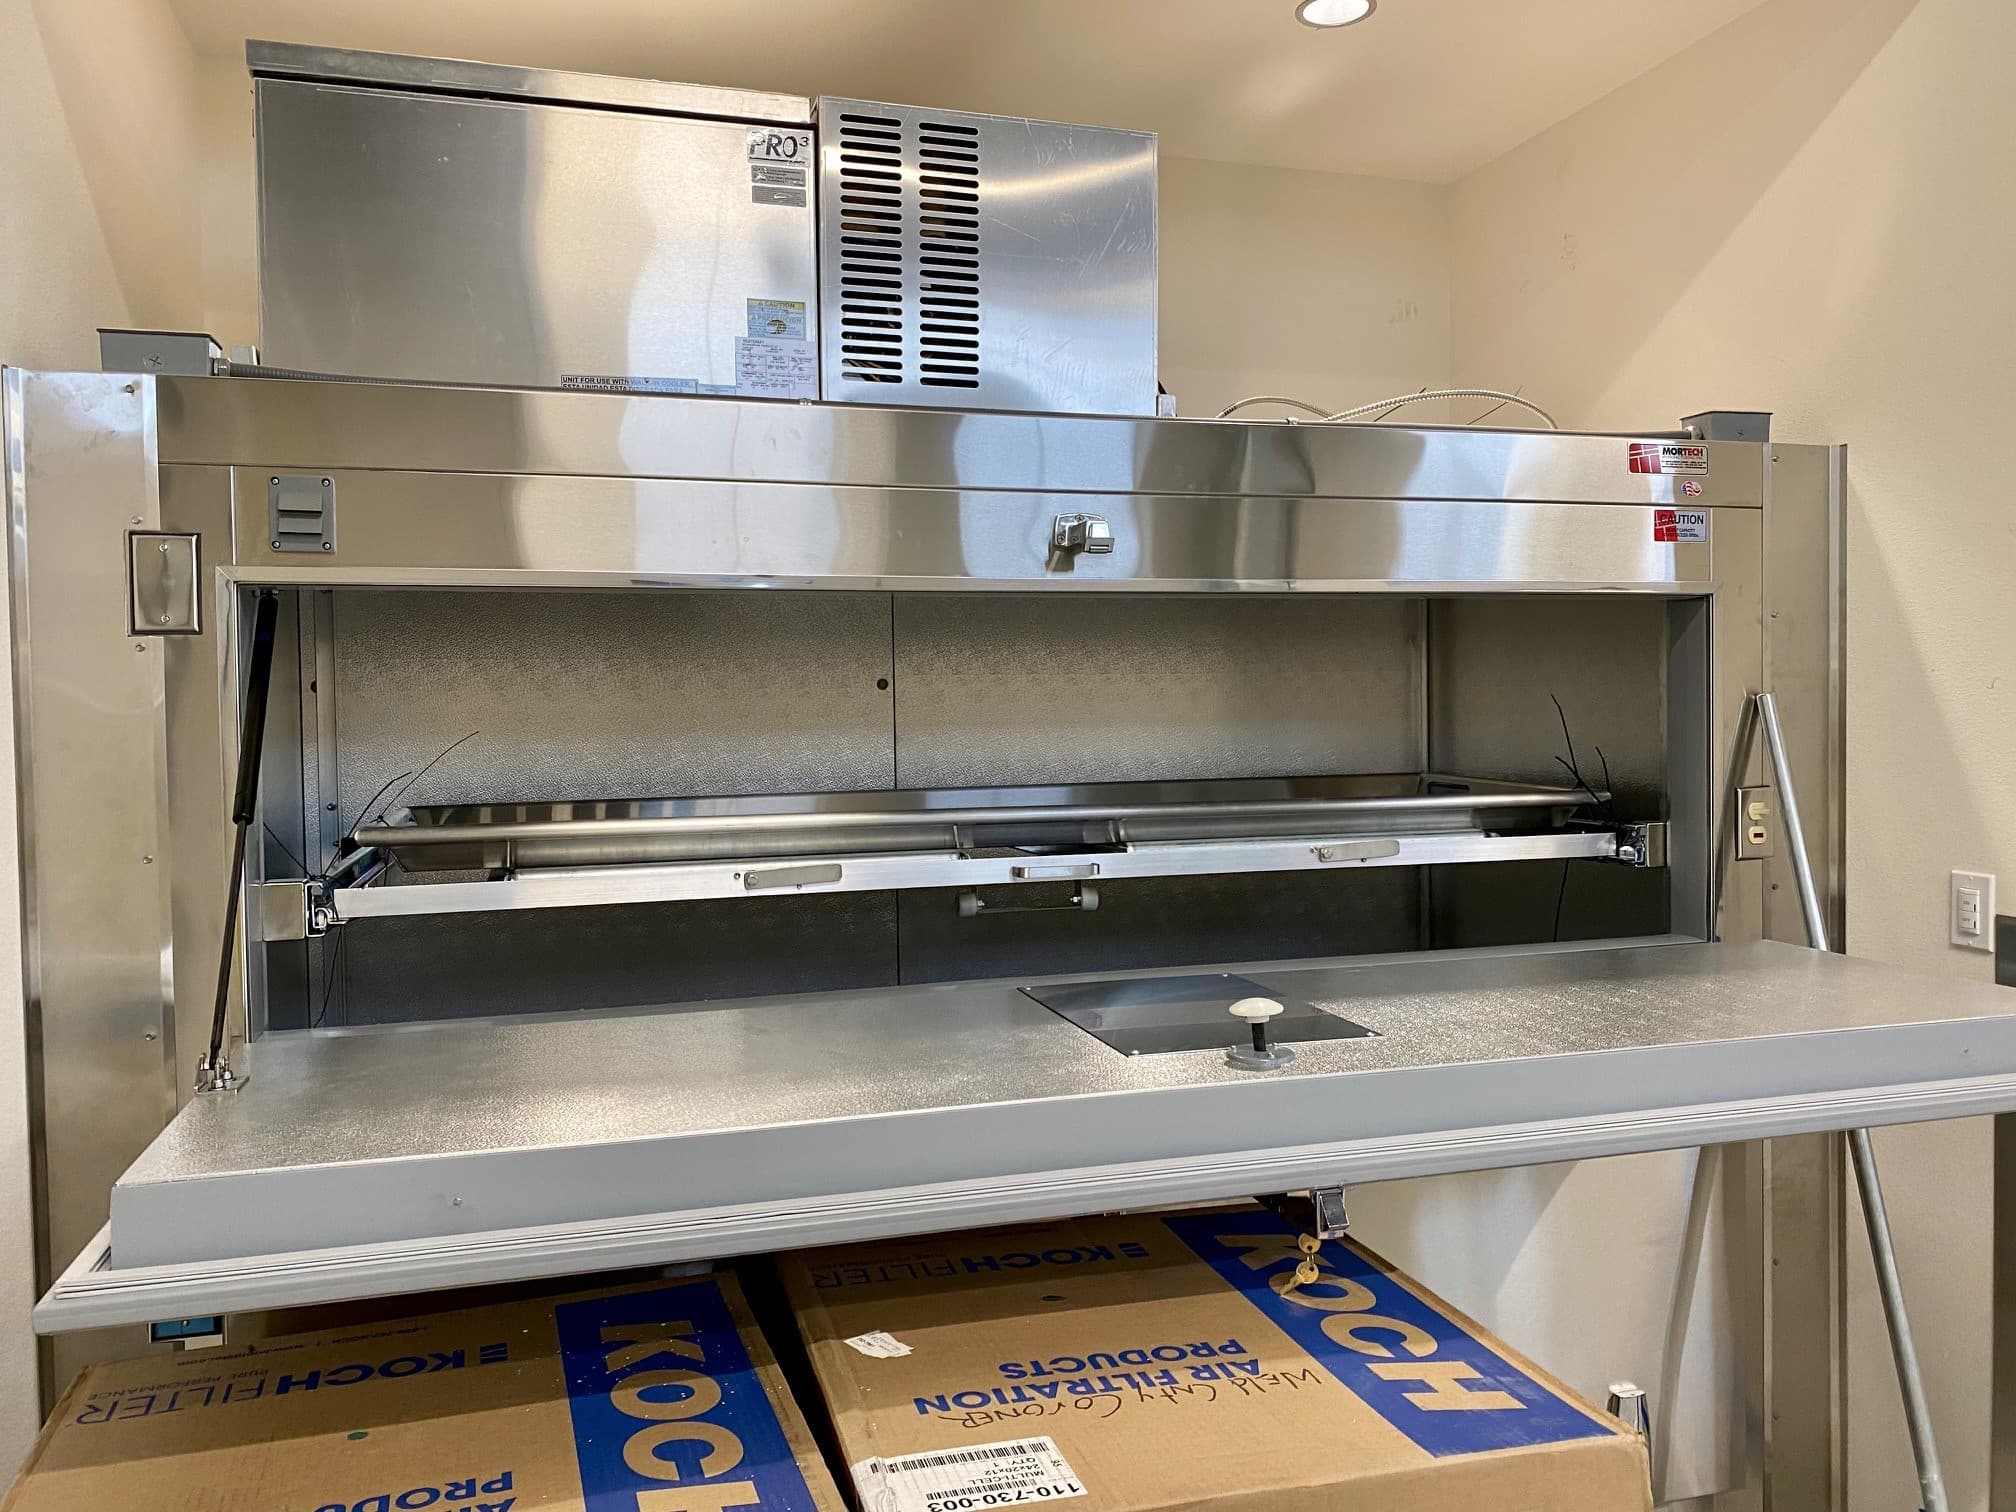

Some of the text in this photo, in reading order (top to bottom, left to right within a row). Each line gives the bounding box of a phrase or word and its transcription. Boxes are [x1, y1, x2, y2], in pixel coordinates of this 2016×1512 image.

[630, 379, 660, 387] WAL-IN
[1662, 447, 1704, 457] MORTECH
[1660, 514, 1704, 525] CAUTION
[813, 1259, 957, 1289] FILTER
[961, 1244, 1115, 1274] KOCH
[1214, 1234, 1527, 1411] KOCH
[276, 1349, 466, 1395] KOCH
[999, 1339, 1248, 1379] PRODUCTS
[76, 1375, 265, 1426] FILTER
[913, 1357, 1261, 1415] AIR FILTRATION
[968, 1469, 1044, 1484] MULTI-CELL
[984, 1463, 1041, 1476] 24x20x12
[927, 1482, 1080, 1511] 110-730-003
